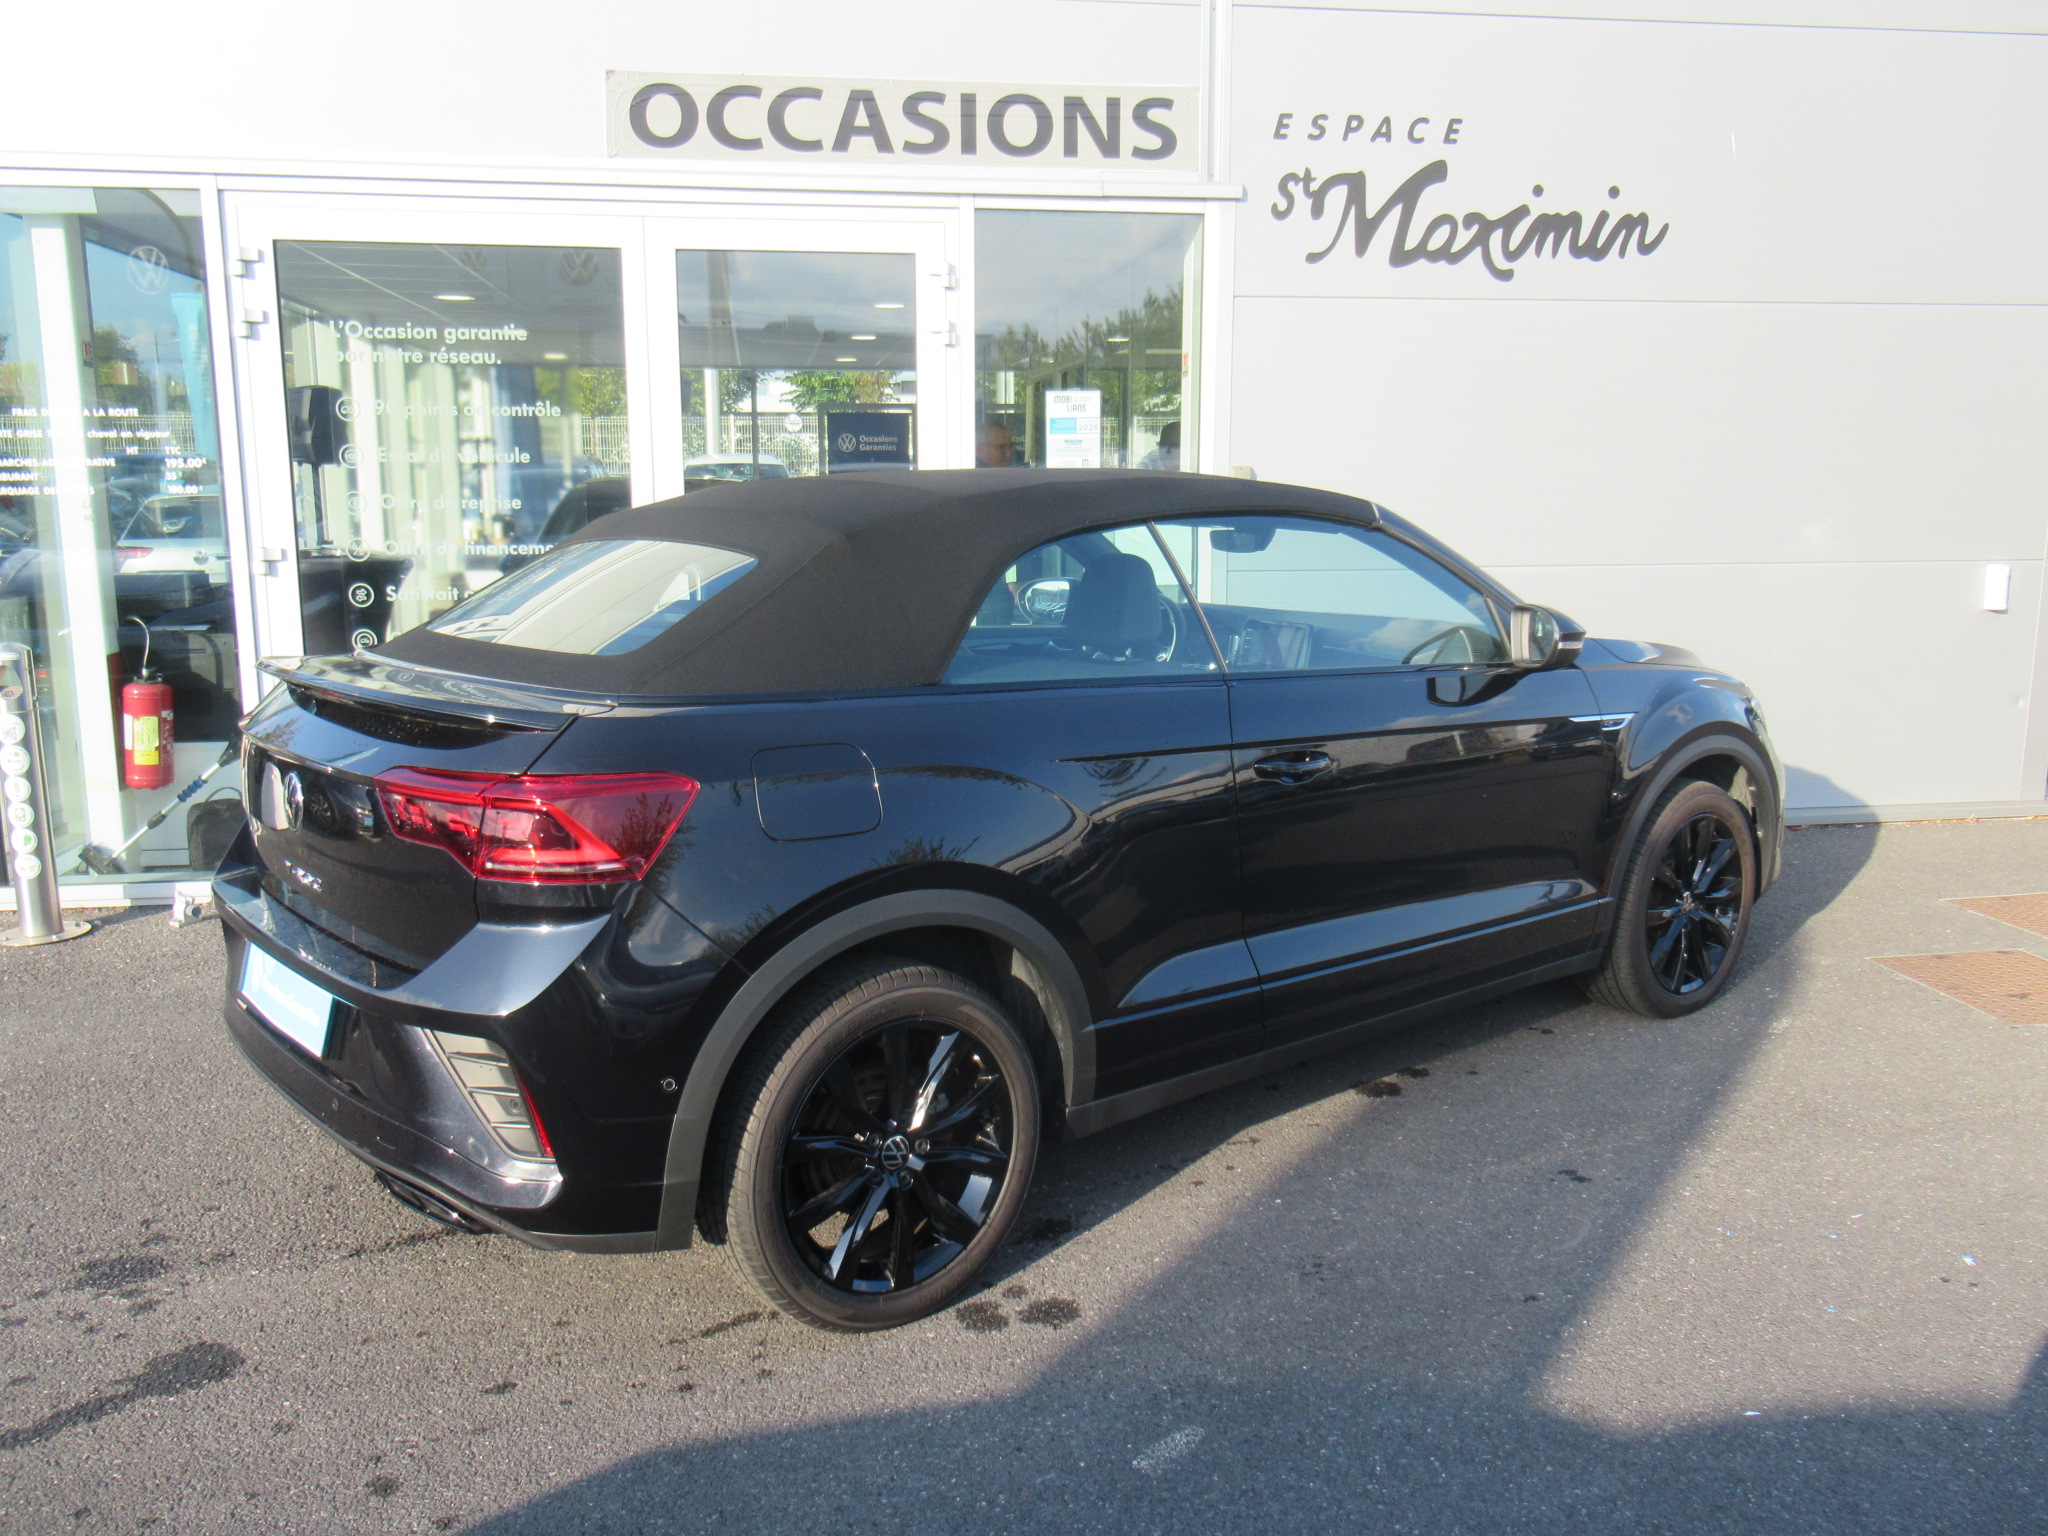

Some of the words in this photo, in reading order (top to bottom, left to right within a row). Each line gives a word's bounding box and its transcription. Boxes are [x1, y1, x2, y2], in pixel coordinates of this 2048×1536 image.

[628, 82, 1179, 161] OCCASIONS
[1272, 112, 1464, 145] ESPACE
[1270, 166, 1317, 221] St
[1304, 158, 1670, 283] Maximin
[329, 320, 438, 340] L'Occasion
[444, 323, 528, 344] garantie
[371, 348, 424, 364] notre
[430, 346, 502, 365] réseau.
[12, 407, 38, 417] FRAIS
[93, 407, 106, 417] LA
[108, 407, 139, 417] ROUTE
[404, 401, 459, 419] points
[463, 399, 485, 416] de
[491, 400, 562, 417] contrôle
[16, 429, 43, 438] GRISE
[120, 430, 133, 438] en
[136, 428, 171, 441] vigueur
[1078, 424, 1099, 432] 2026
[859, 435, 898, 443] Occasions
[126, 446, 139, 455] HT
[164, 446, 182, 455] TTC
[859, 444, 897, 452] Garanties
